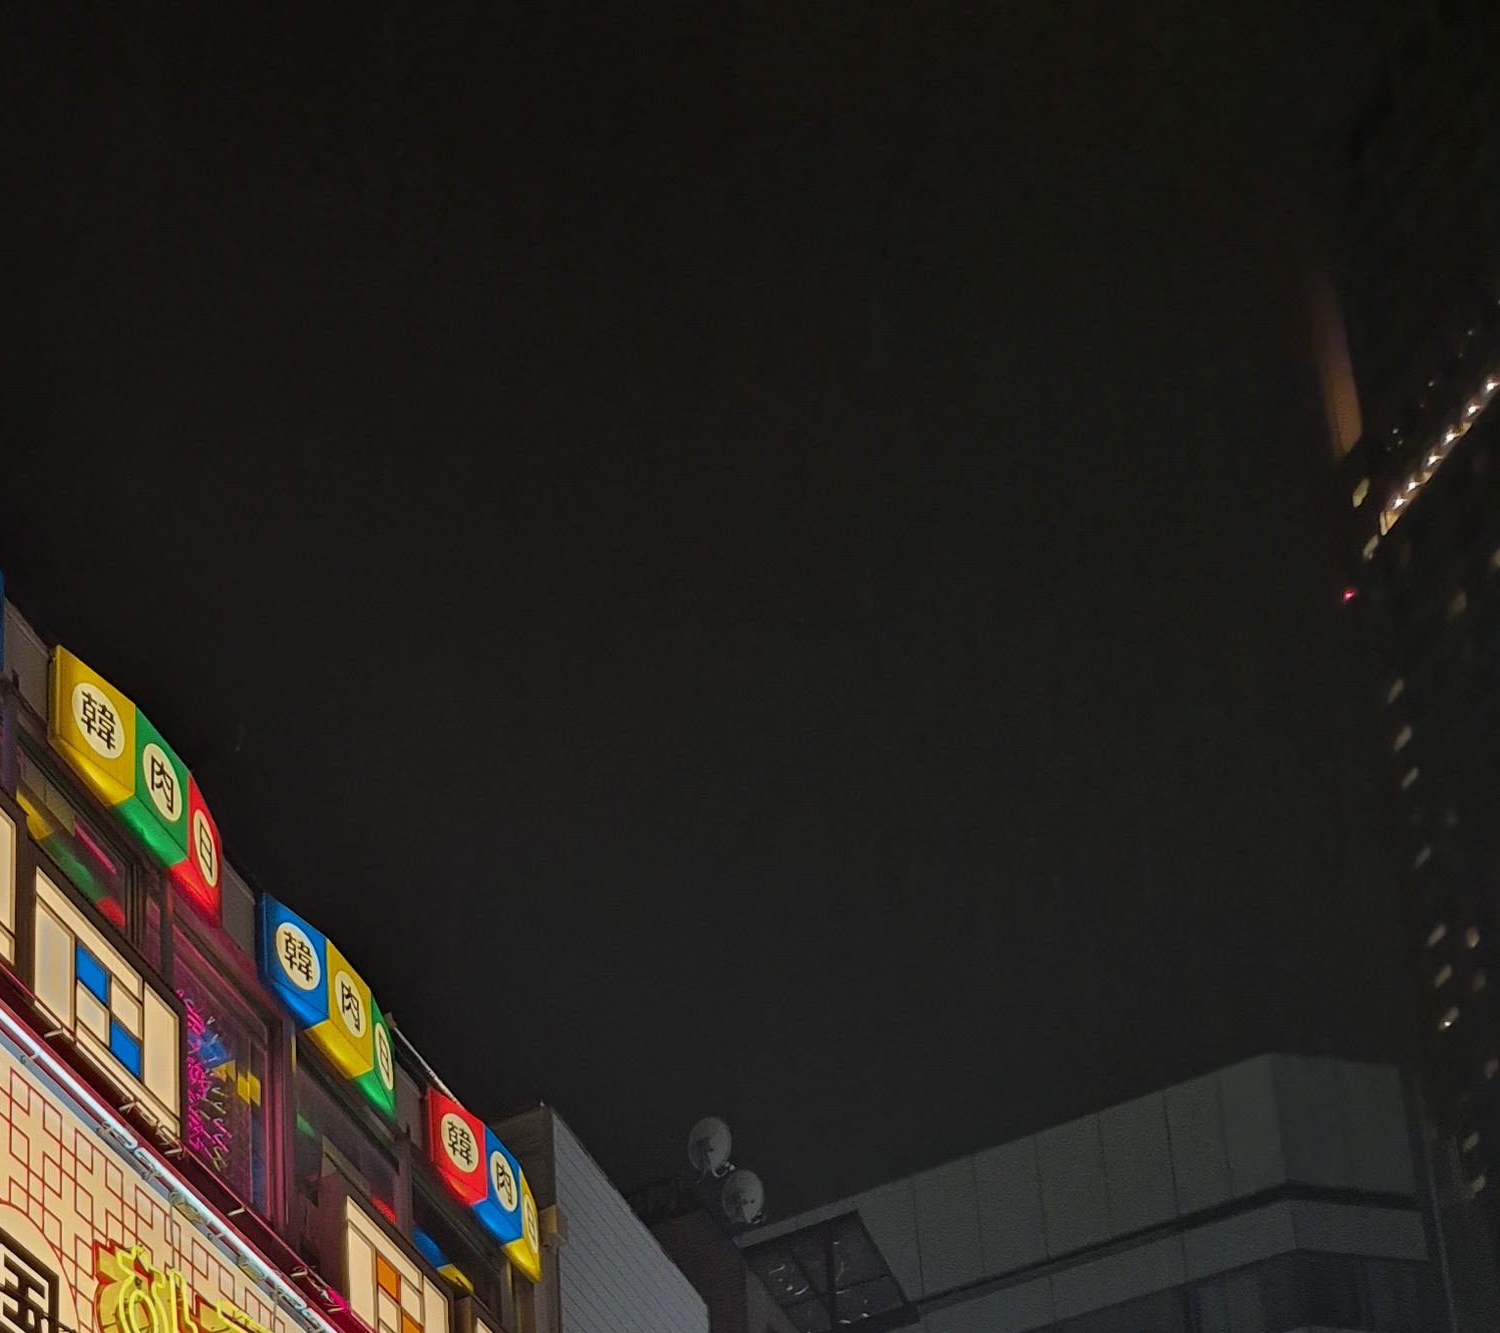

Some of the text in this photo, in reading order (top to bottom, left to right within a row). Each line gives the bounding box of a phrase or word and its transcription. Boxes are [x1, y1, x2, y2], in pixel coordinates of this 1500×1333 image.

[79, 690, 119, 753] 韓
[149, 755, 177, 815] 肉
[198, 815, 214, 876] 日
[282, 930, 314, 983] 韓
[340, 984, 366, 1032] 肉
[377, 1027, 392, 1081] 日
[447, 1119, 474, 1167] 韓
[495, 1158, 514, 1205] 肉
